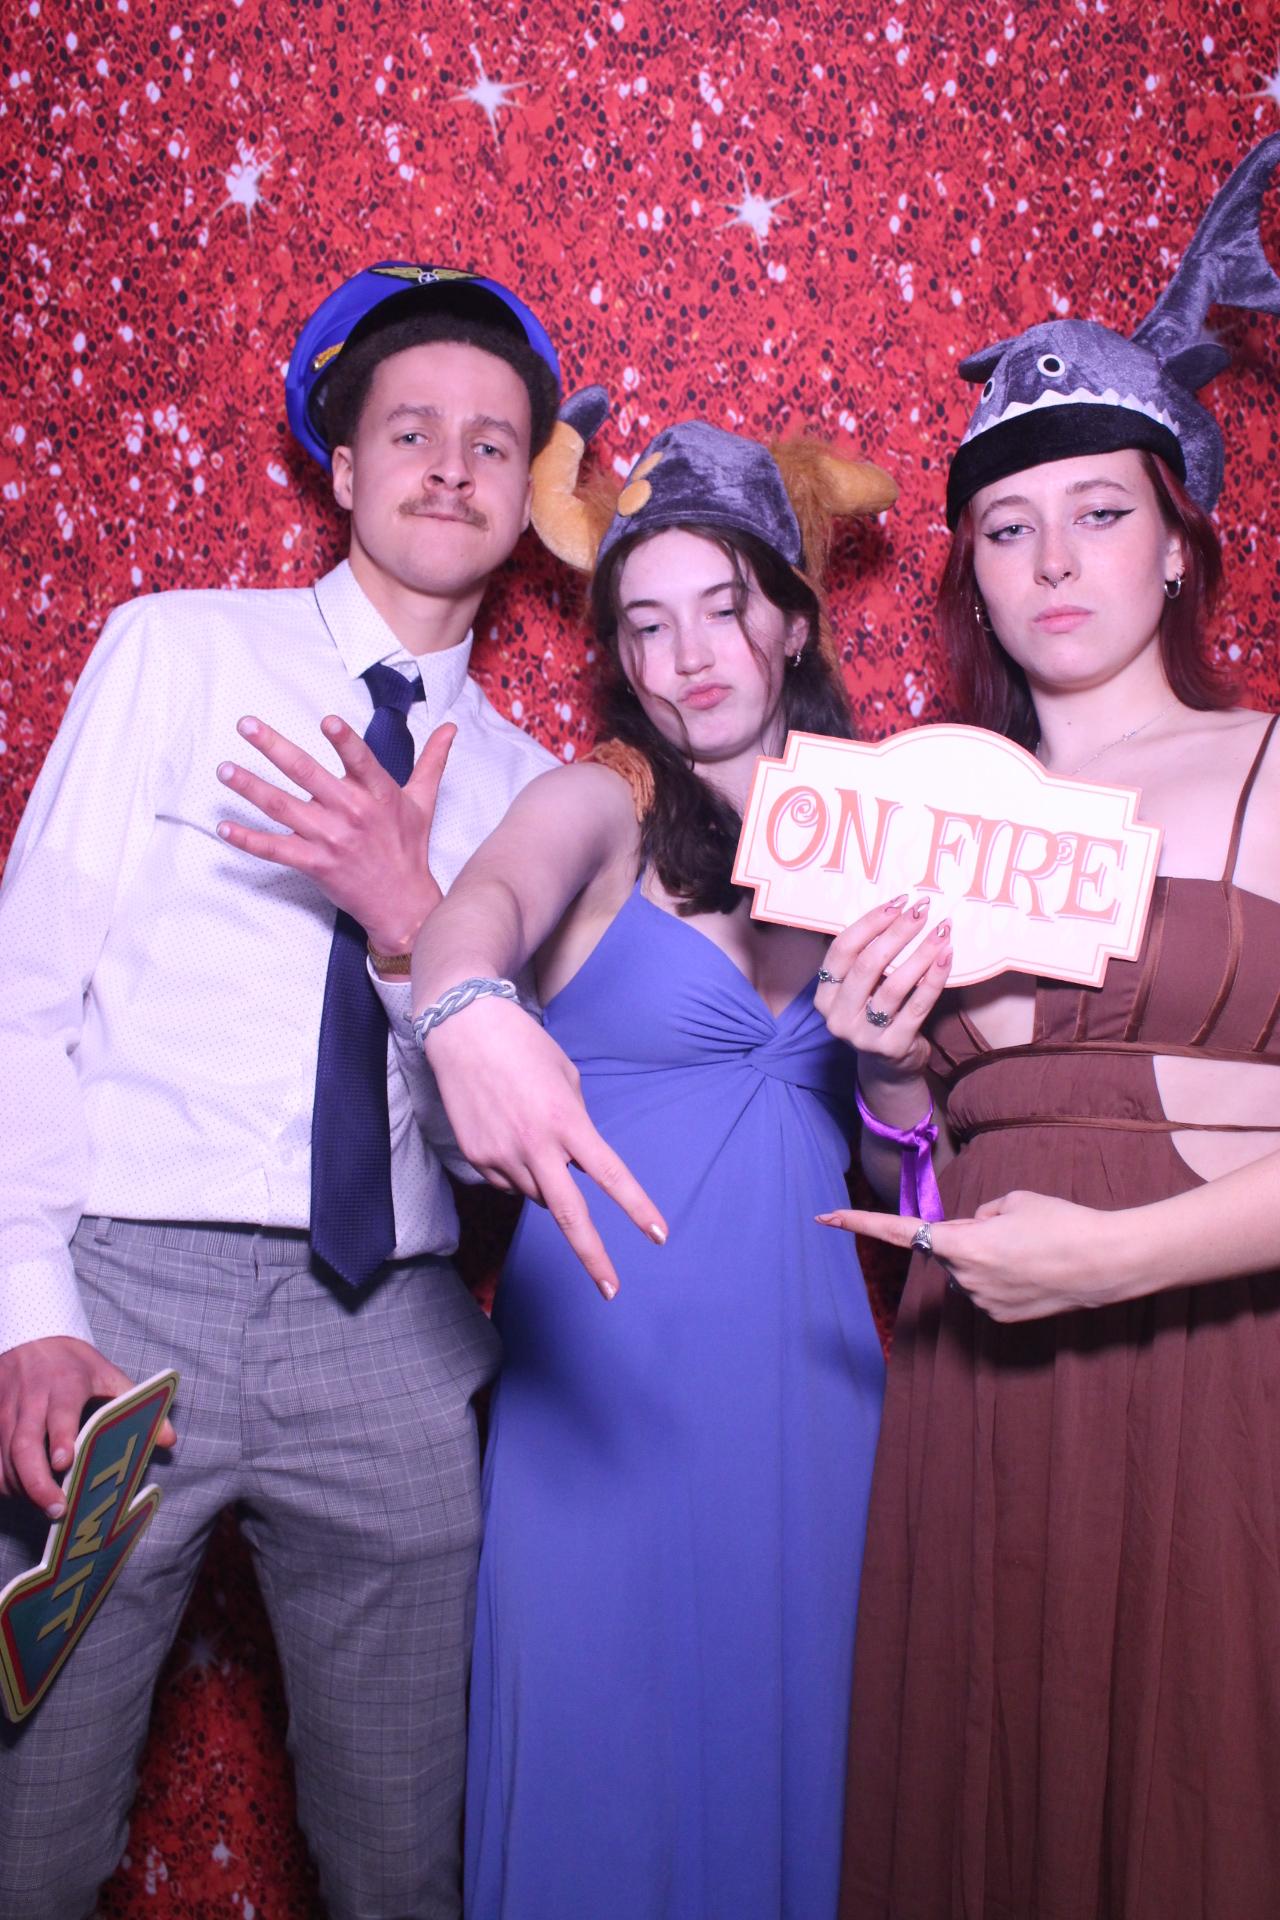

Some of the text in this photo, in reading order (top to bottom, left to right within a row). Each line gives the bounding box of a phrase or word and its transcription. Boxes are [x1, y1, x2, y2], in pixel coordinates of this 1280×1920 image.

[766, 786, 1127, 923] ON FIRE
[37, 1433, 138, 1642] TWIT
